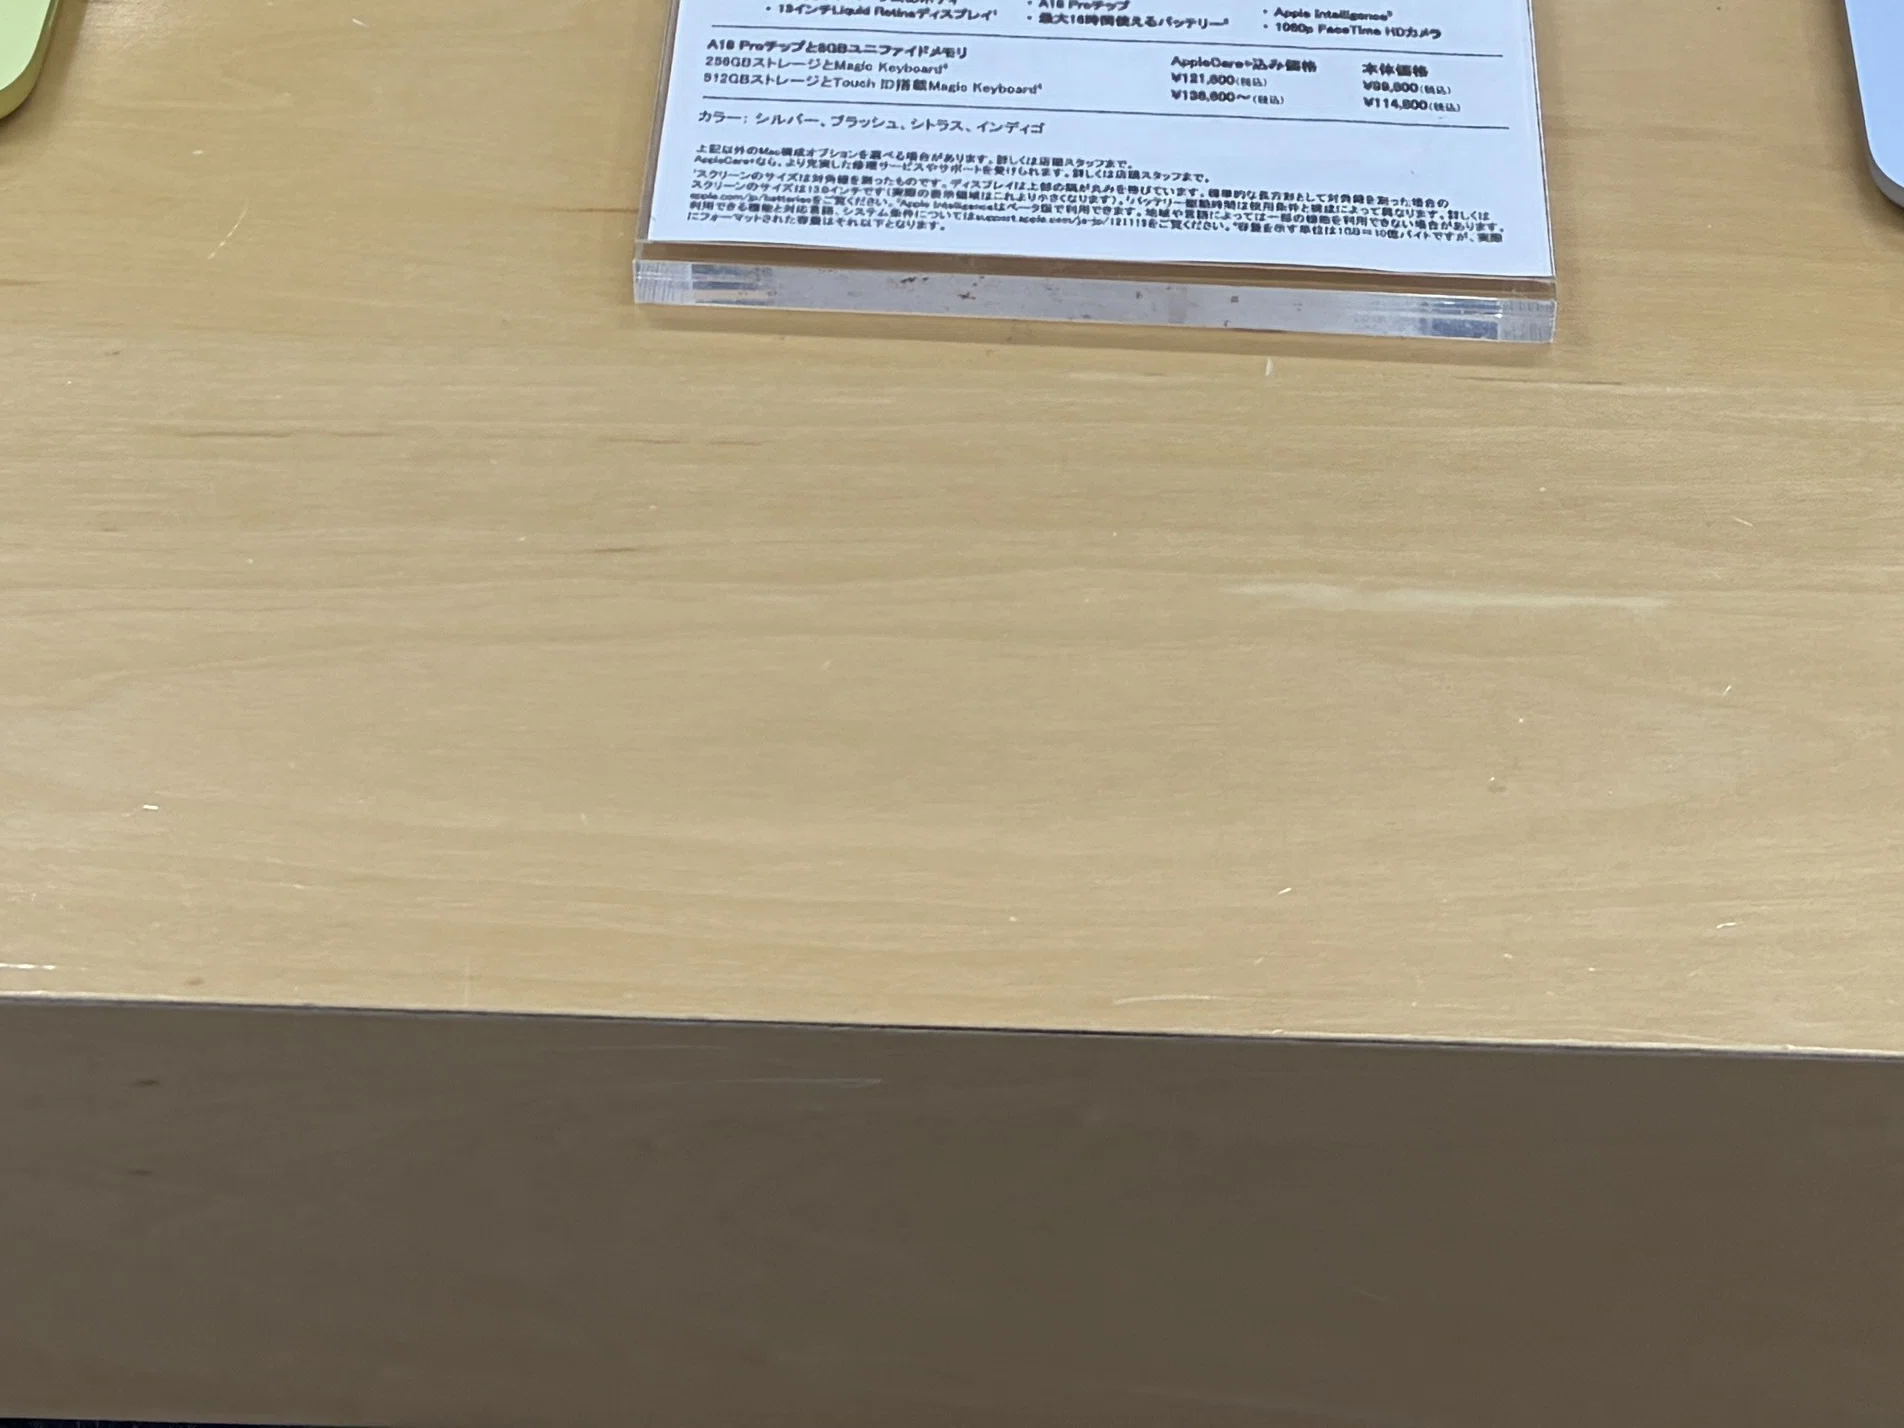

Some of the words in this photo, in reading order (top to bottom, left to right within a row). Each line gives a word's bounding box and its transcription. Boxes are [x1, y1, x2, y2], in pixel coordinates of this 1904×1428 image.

[1068, 0, 1130, 12] Proチップ
[1274, 6, 1311, 20] Apple
[1361, 62, 1429, 78] 本体価格
